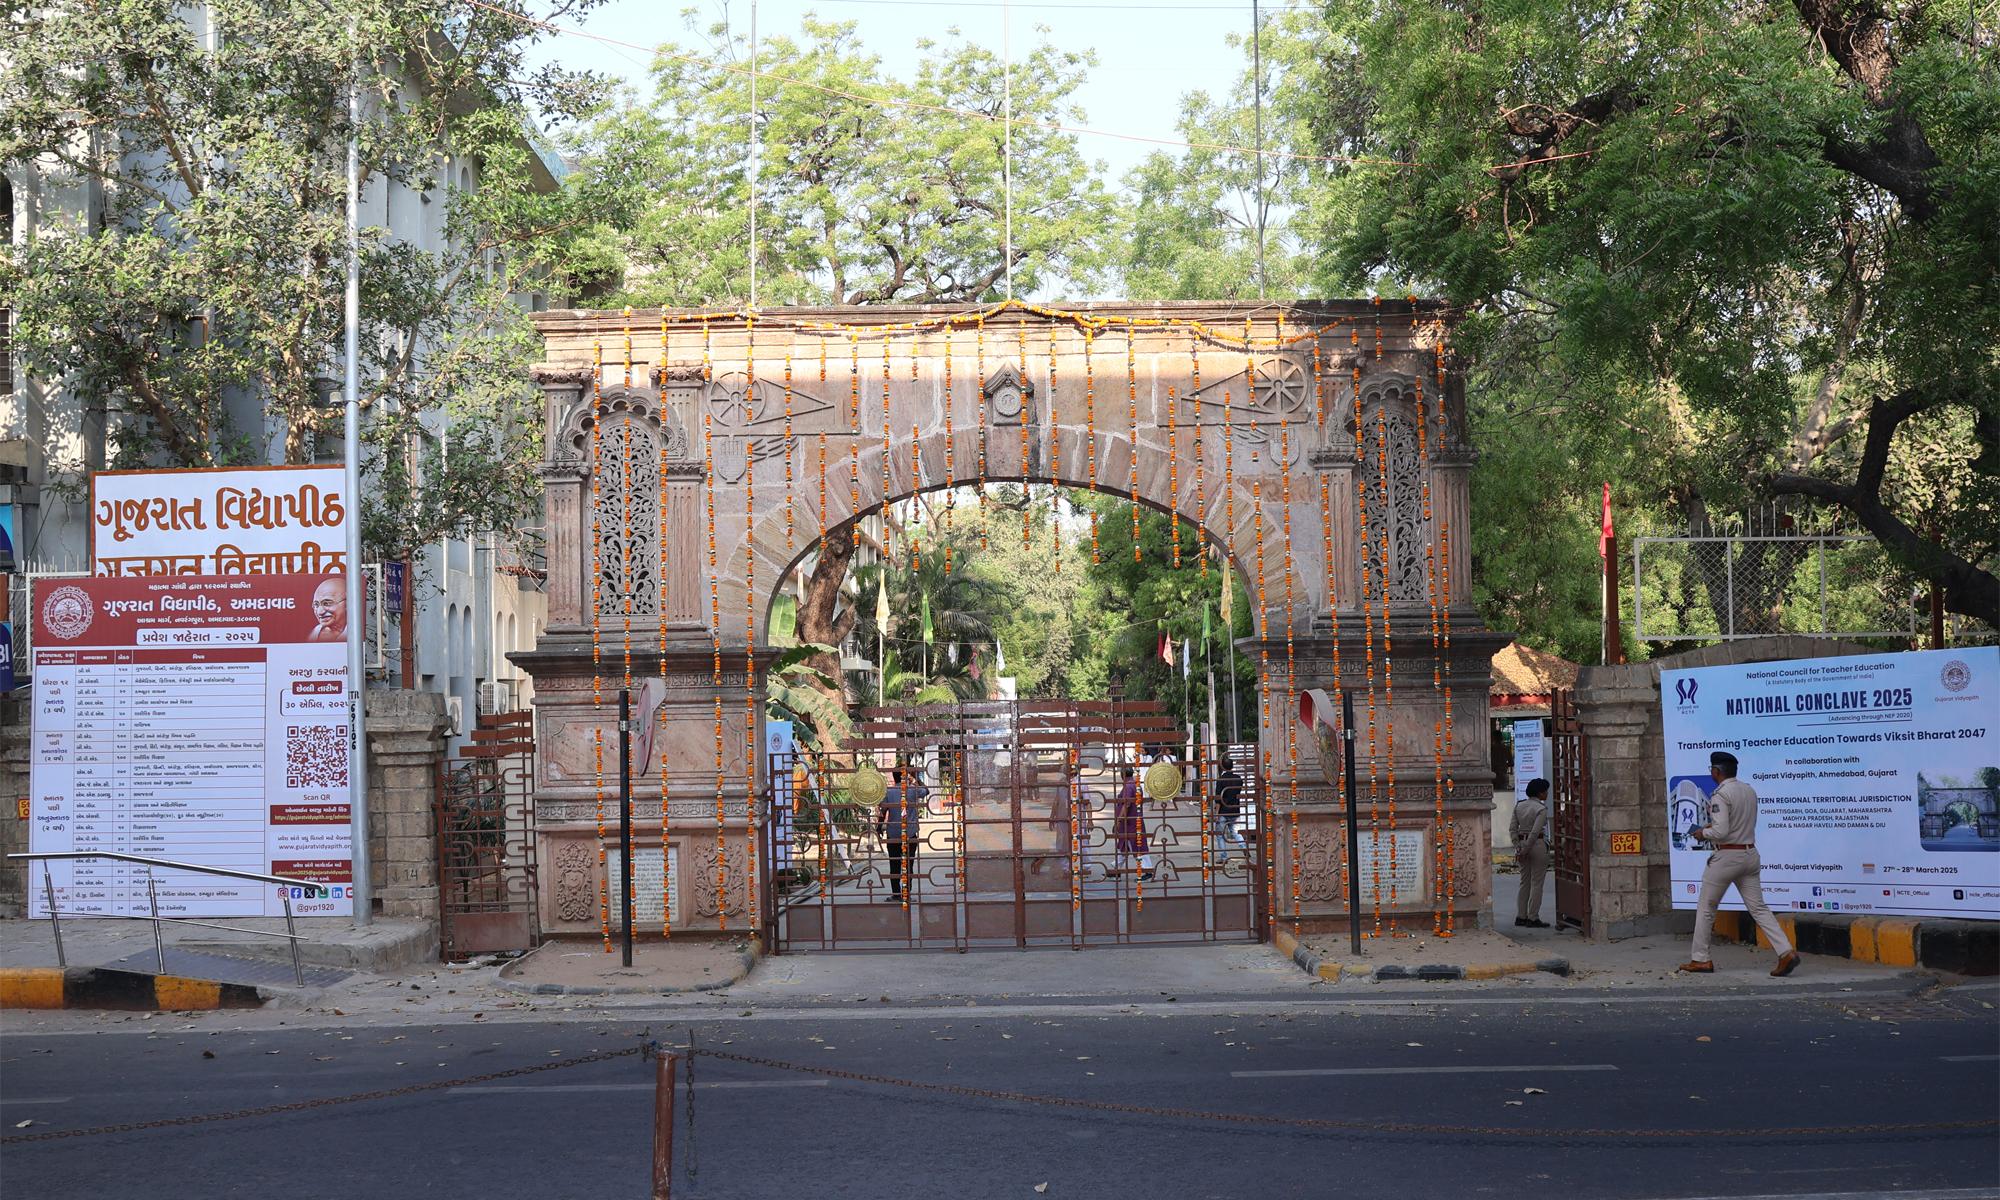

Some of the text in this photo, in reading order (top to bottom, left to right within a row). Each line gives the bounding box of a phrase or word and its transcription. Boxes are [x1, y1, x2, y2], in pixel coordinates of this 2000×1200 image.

[97, 484, 344, 542] ગૂજરાત વિદ્યાપીઠ
[102, 600, 154, 616] ગૂજરાત
[230, 598, 296, 610] અમદાવાદ
[143, 630, 168, 642] પ્રવેશ
[173, 630, 210, 642] જાહેરાત
[226, 632, 254, 640] ૨૦૨૫
[289, 666, 348, 678] અરજી કરવાની
[1746, 662, 1895, 679] National Council for Teacher Education
[1726, 688, 1912, 715] NATIONAL CONCLAVE 2025
[1678, 728, 1986, 750] Transforming Teacher Education Towards Viksit Bharat 2047
[1794, 757, 1842, 765] collaboration
[1752, 773, 1779, 781] Gujarat
[1780, 772, 1817, 780] Vidyapith,
[1868, 770, 1897, 778] Gujarat
[1776, 796, 1811, 804] REGIONAL
[1784, 864, 1809, 872] Gujarat
[297, 904, 334, 912] @gvp1920
